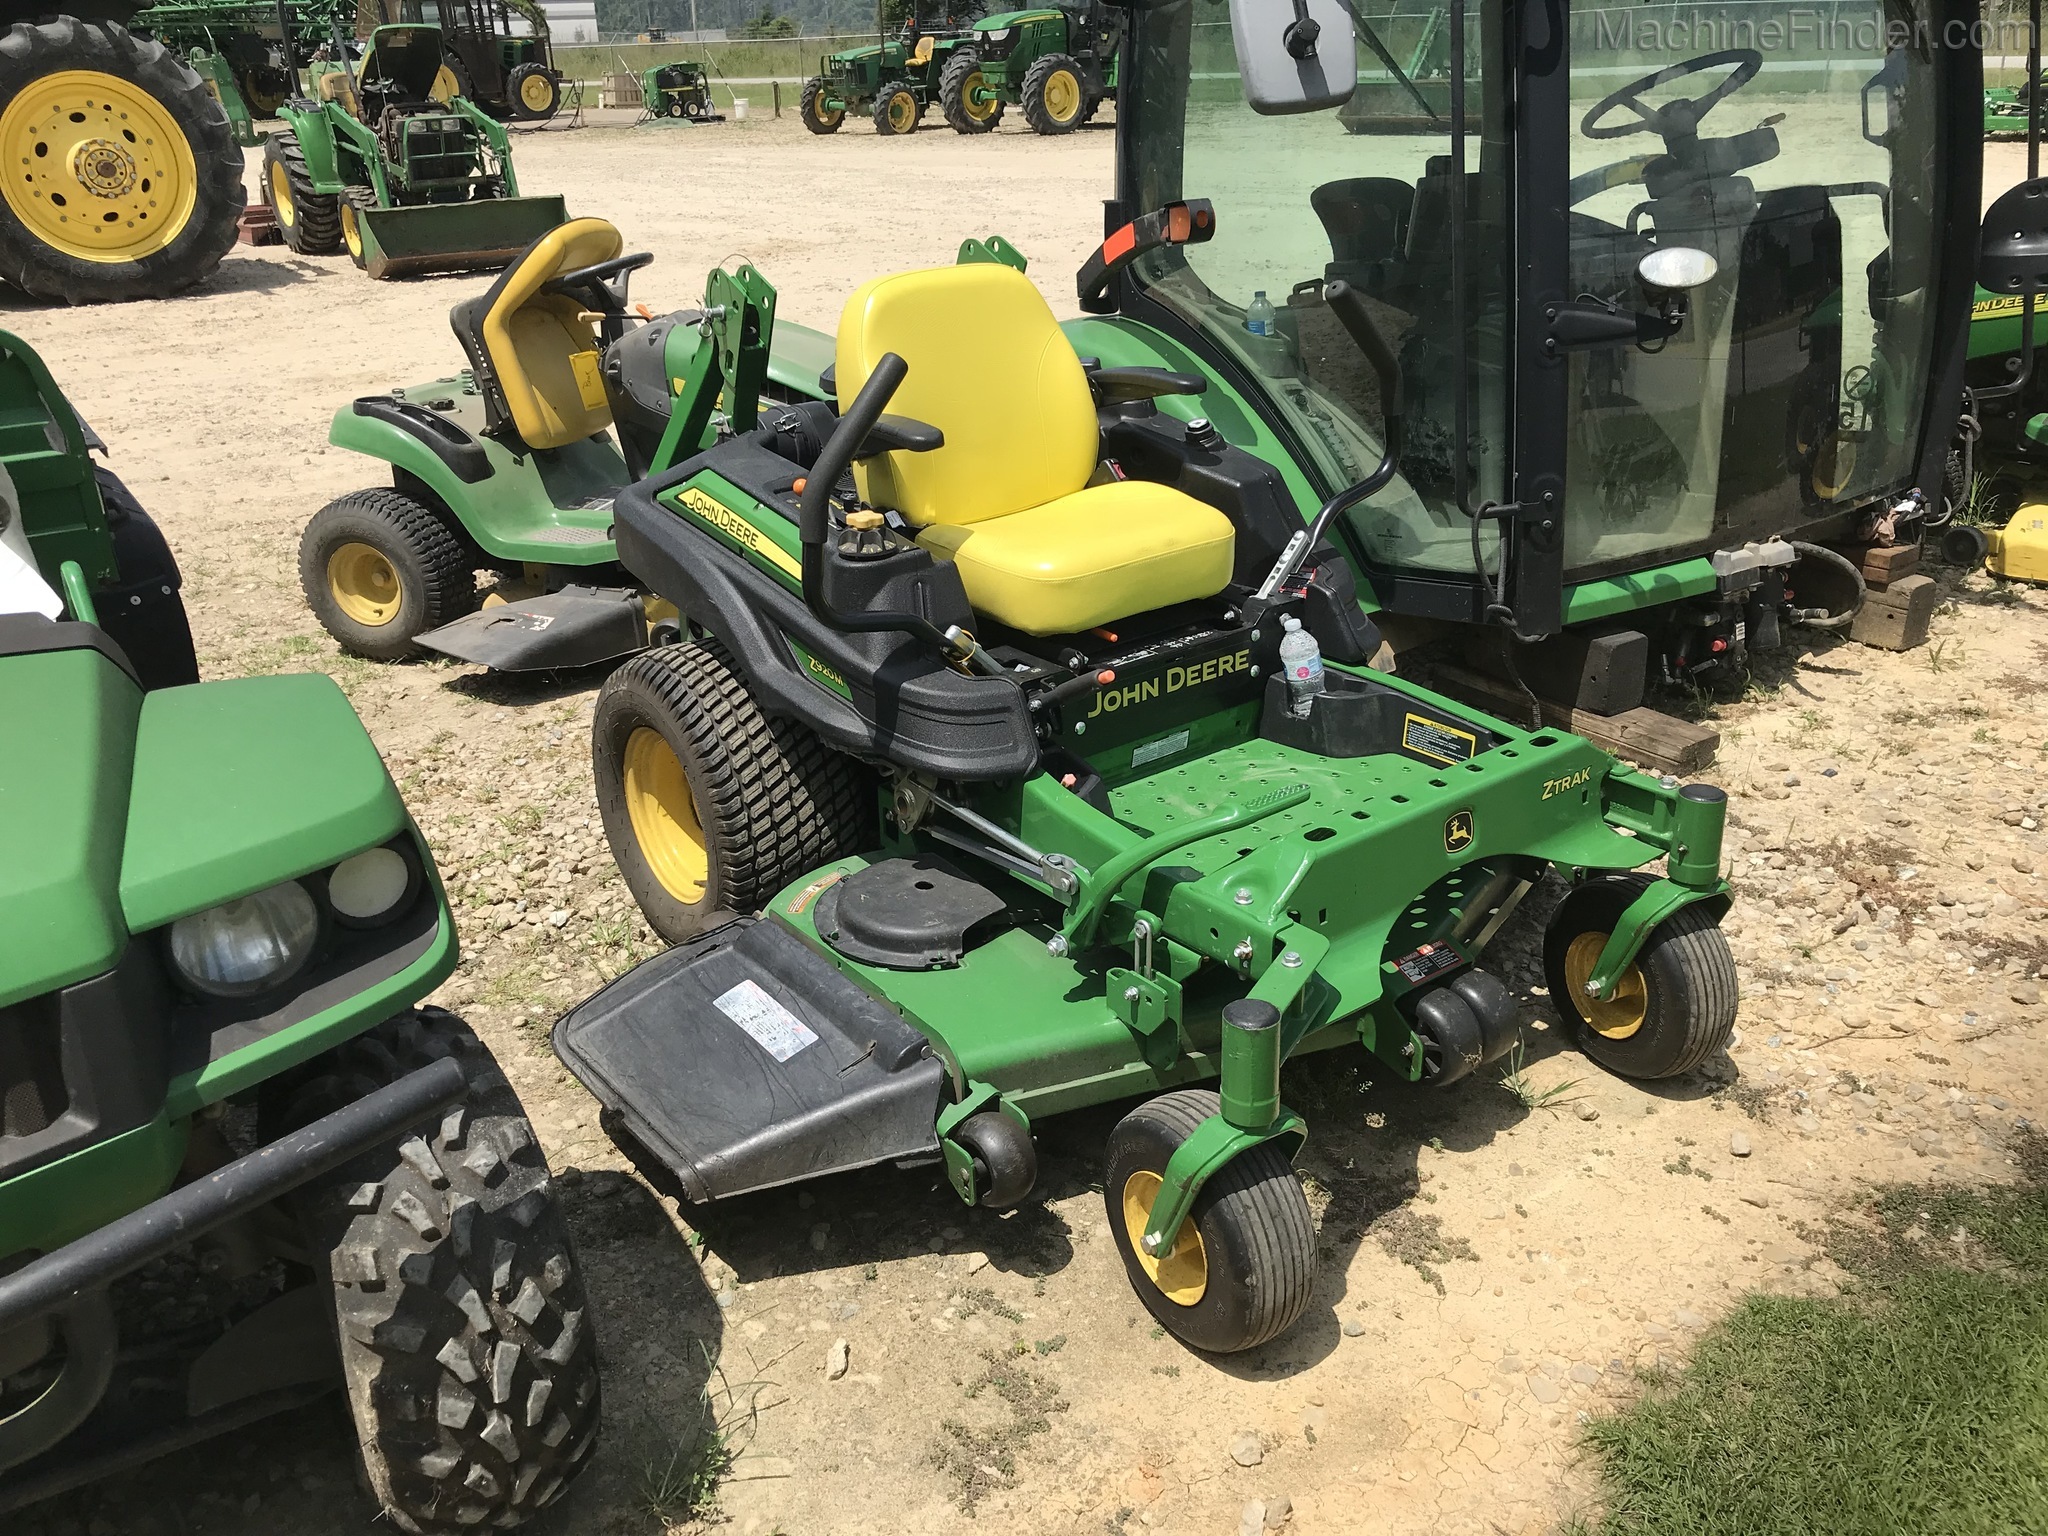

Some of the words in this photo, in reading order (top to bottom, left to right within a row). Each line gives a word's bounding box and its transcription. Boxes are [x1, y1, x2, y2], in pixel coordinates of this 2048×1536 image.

[688, 492, 720, 523] JOHN
[720, 510, 759, 548] DEERE
[807, 654, 844, 687] Z920M
[1087, 677, 1159, 719] JOHN
[1166, 648, 1250, 694] DEERE
[1541, 766, 1591, 801] ZTRAK
